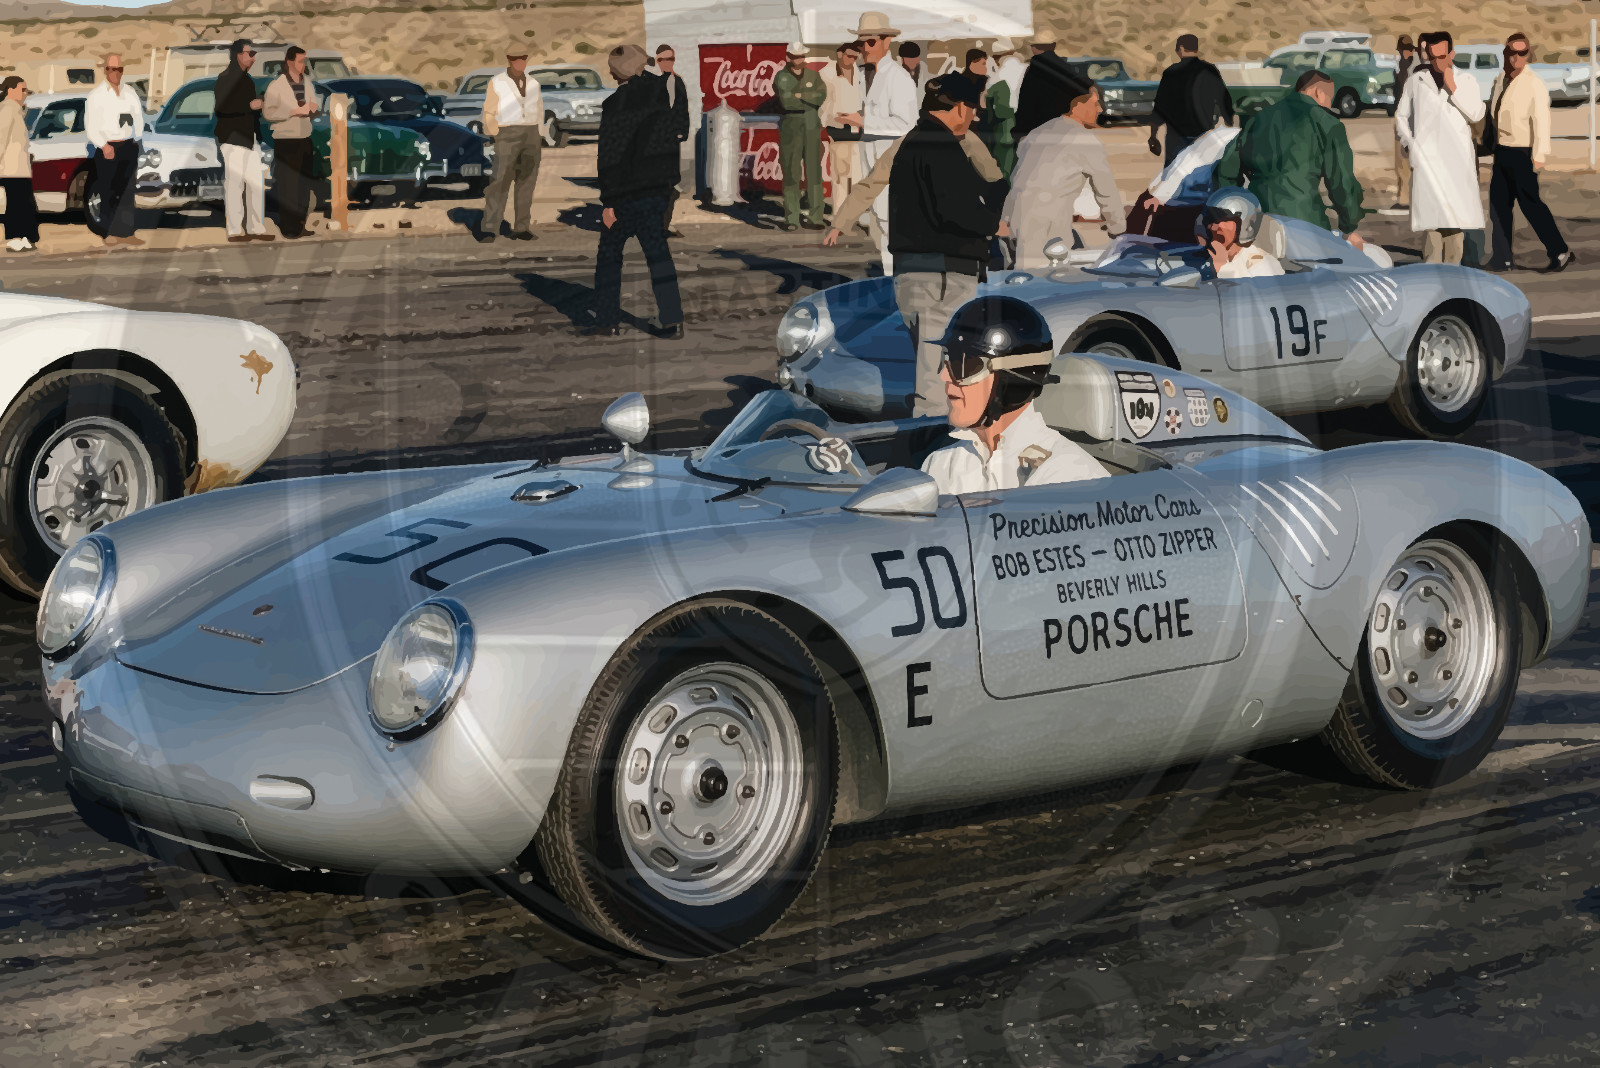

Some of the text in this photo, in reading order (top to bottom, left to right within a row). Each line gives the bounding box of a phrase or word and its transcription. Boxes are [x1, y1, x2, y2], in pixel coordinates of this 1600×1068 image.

[988, 492, 1202, 541] Precision Motor Cars
[992, 554, 1030, 581] BOB
[1032, 545, 1086, 574] ESTES
[1114, 533, 1156, 562] OTTO
[1158, 527, 1218, 557] ZIPPER
[870, 545, 968, 638] 50
[1056, 570, 1167, 603] BEVERLY HILLS
[1043, 597, 1194, 660] PORSCHE
[905, 661, 933, 729] E
